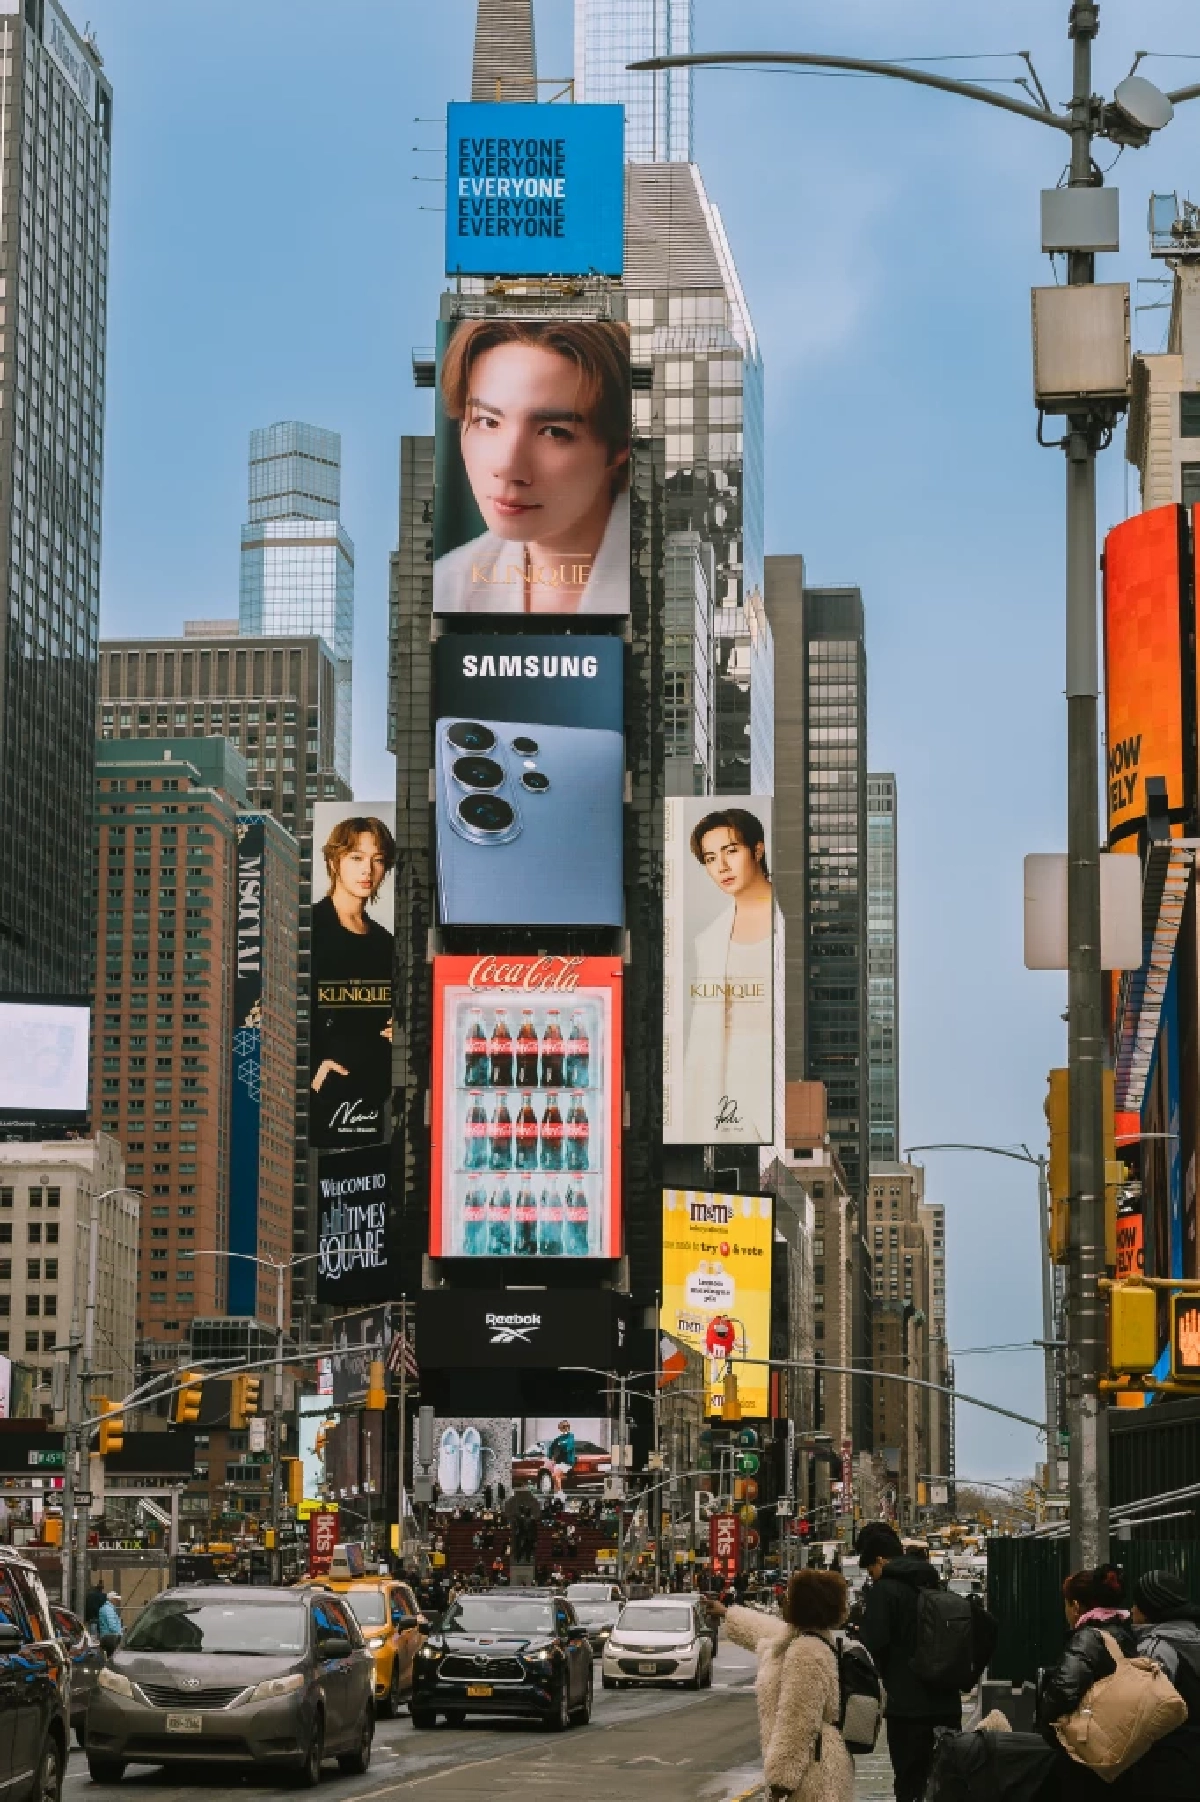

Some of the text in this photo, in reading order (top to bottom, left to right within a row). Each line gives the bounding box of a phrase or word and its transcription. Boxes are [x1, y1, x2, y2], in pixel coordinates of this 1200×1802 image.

[458, 139, 566, 157] EVERYONE
[458, 158, 566, 177] EVERYONE
[458, 178, 566, 197] EVERYONE
[458, 199, 566, 217] EVERYONE
[458, 218, 566, 238] EVERYONE
[462, 655, 598, 678] SAMSUNG
[320, 1176, 371, 1197] WELCOME
[318, 1229, 387, 1280] SQUARE
[486, 1313, 541, 1326] Reebok
